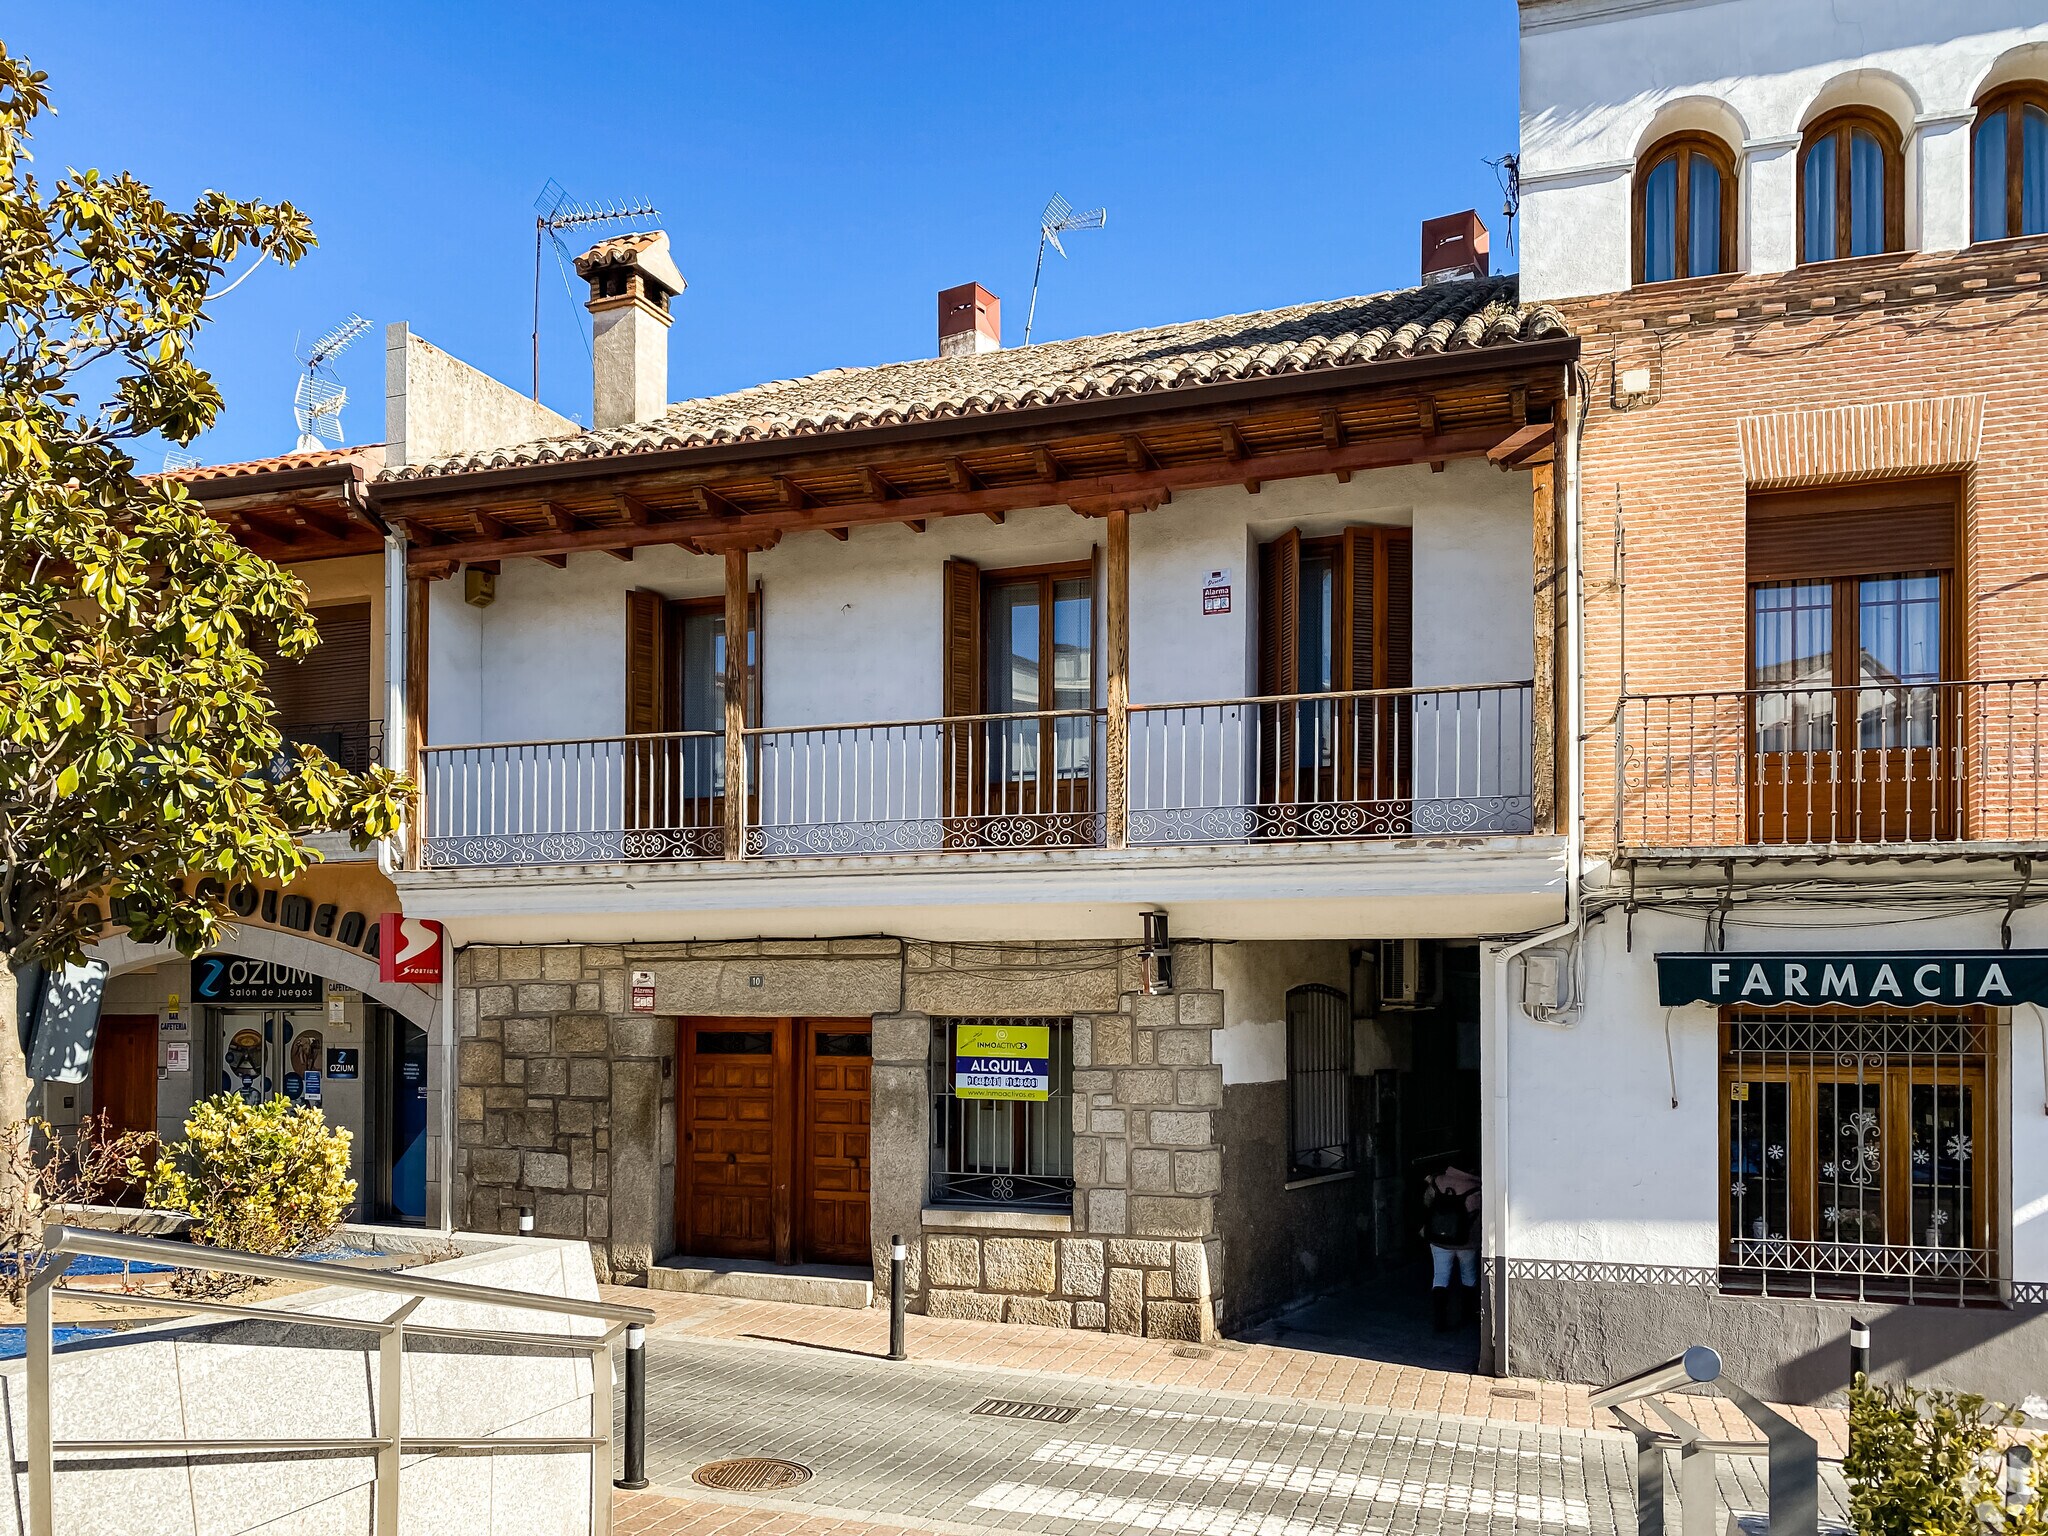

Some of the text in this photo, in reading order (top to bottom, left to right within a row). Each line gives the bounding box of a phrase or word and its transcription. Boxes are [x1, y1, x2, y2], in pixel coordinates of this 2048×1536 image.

[1205, 588, 1229, 596] Alarma
[398, 964, 439, 976] SPORTIUM
[752, 977, 761, 985] 10
[1711, 963, 2013, 998] FARMACIA
[229, 988, 257, 996] Salón
[261, 988, 274, 996] de
[977, 1041, 1028, 1050] INMOACTIVOS
[970, 1059, 1034, 1073] ALQUILA
[967, 1089, 1035, 1098] www.inmoactivos.es
